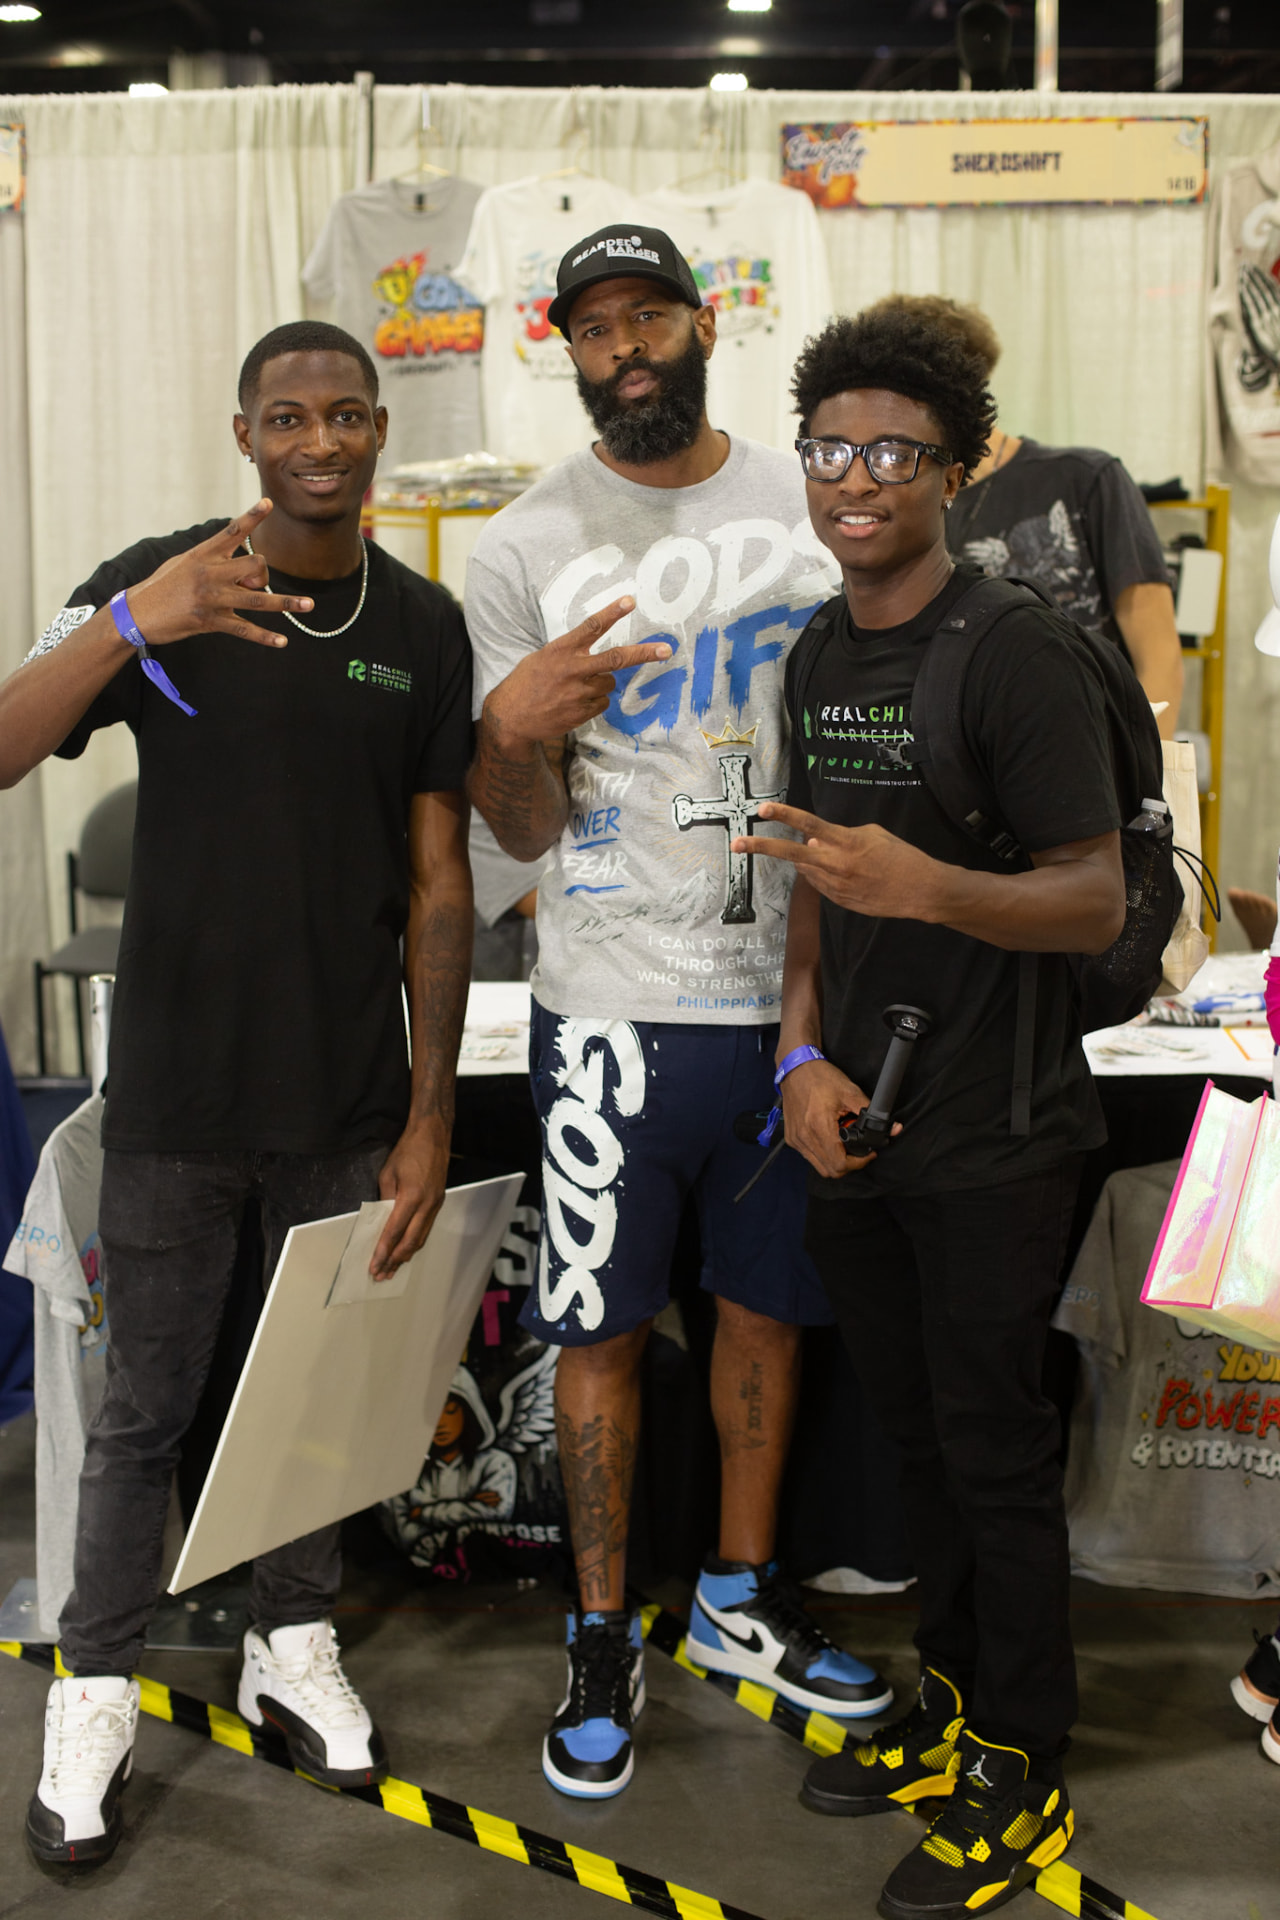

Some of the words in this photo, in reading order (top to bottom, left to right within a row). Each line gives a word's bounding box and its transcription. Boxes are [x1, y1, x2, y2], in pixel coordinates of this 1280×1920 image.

[371, 675, 411, 693] SYSTEMS
[821, 705, 911, 722] REALCHI
[573, 805, 621, 839] OVER
[562, 850, 630, 880] FEAR
[660, 936, 697, 951] CAN
[703, 937, 728, 952] DO
[735, 936, 766, 950] ALL
[663, 955, 748, 973] THROUGH
[636, 970, 681, 986] WHO
[676, 993, 776, 1010] PHILIPPIANS
